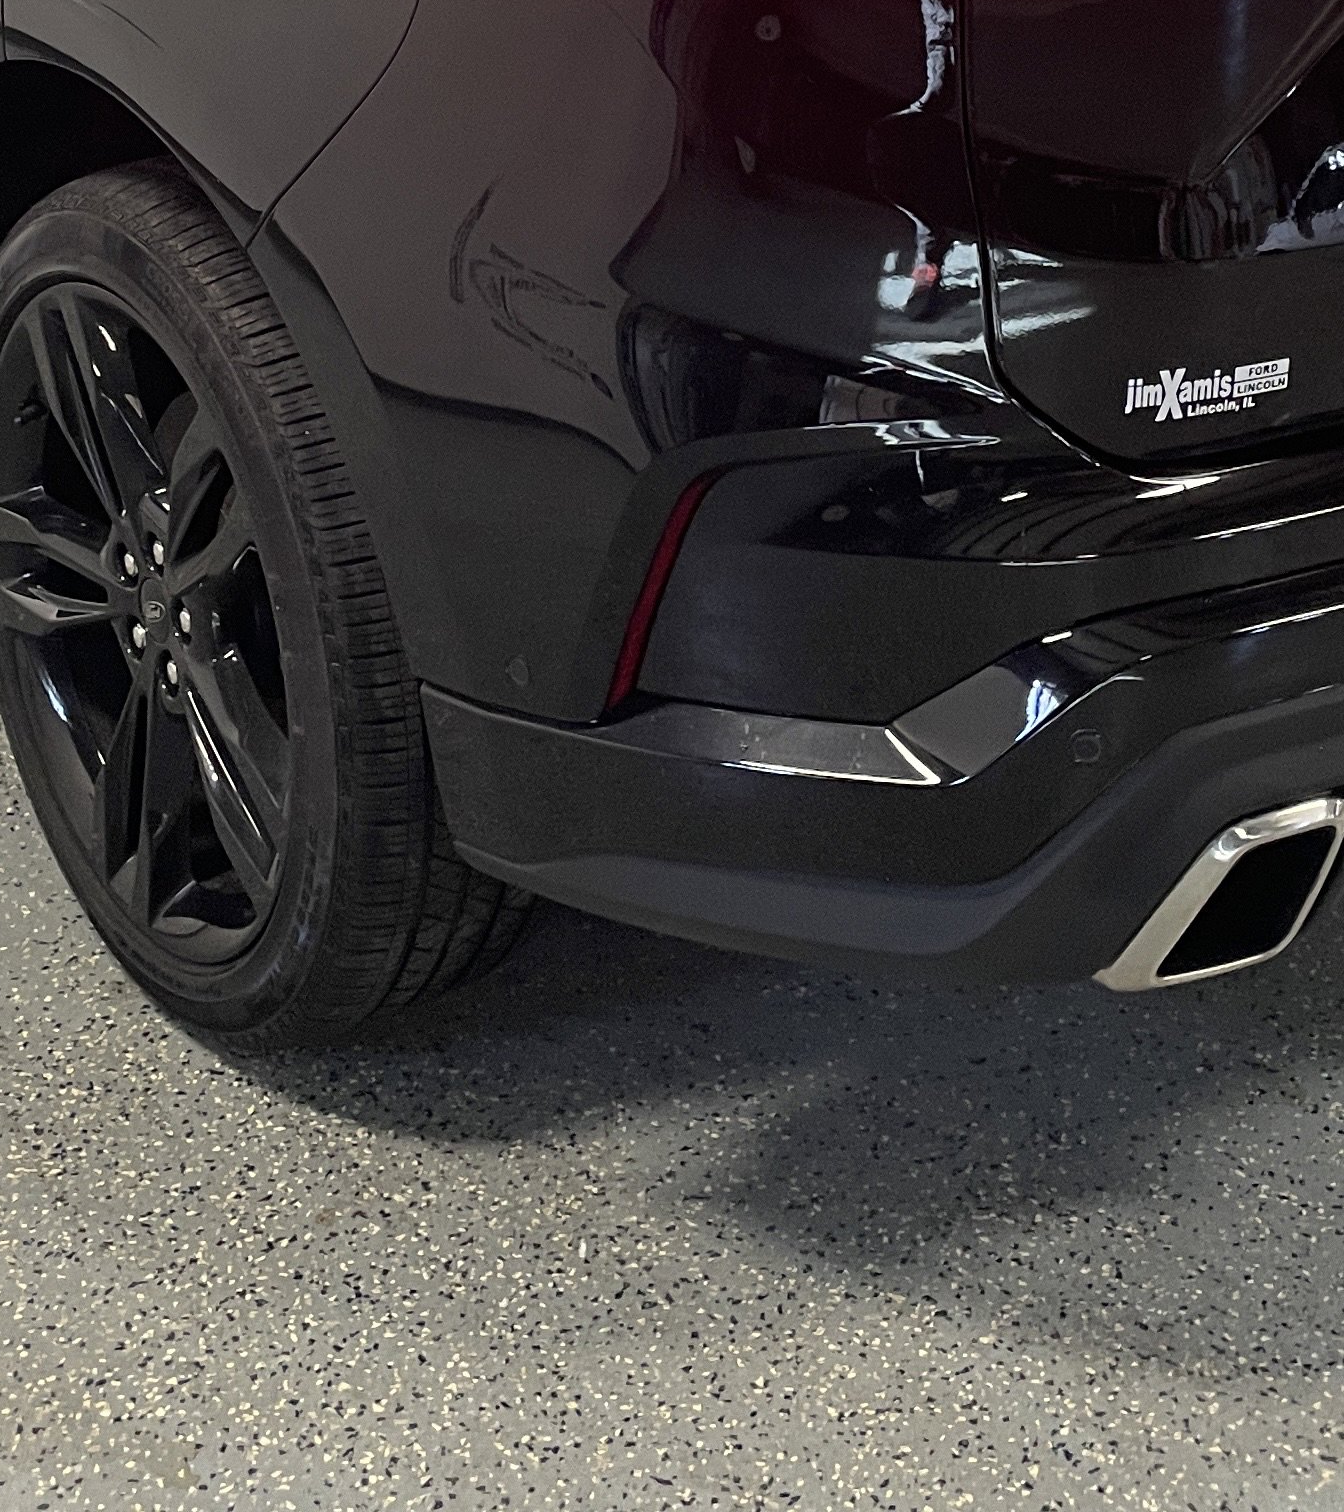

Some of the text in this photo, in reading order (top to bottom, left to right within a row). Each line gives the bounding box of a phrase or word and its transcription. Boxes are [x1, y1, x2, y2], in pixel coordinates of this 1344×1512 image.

[1248, 363, 1279, 377] FORD
[1236, 377, 1286, 394] LINCOLN
[1186, 396, 1256, 417] Lincoln, IL
